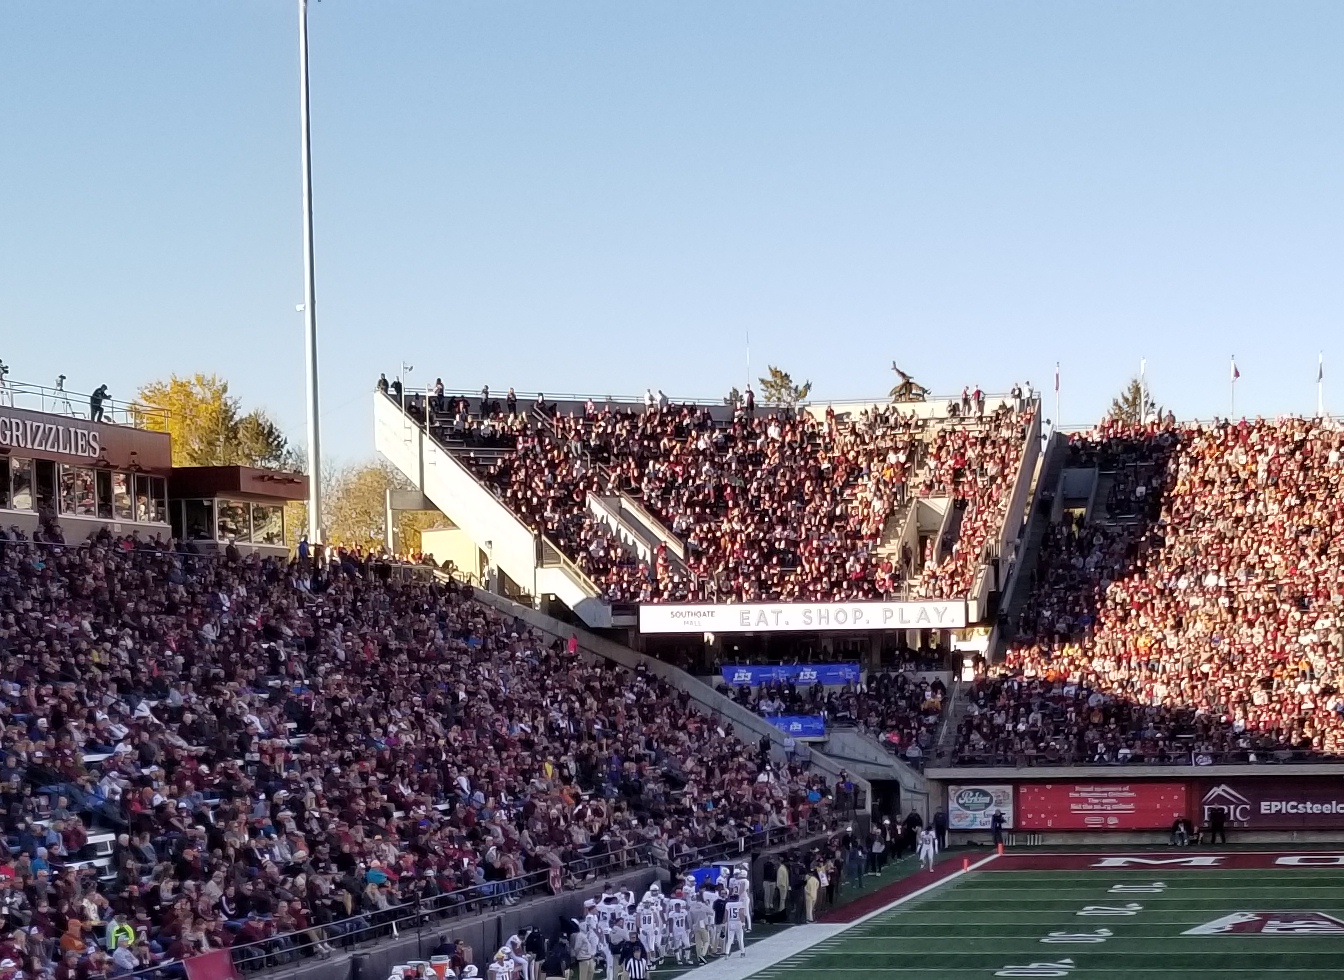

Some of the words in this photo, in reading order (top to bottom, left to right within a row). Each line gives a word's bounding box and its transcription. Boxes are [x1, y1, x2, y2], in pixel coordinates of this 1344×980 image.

[670, 610, 716, 619] SOUTHGATE
[740, 609, 789, 627] EAT.
[802, 608, 869, 625] SHOP.
[882, 606, 955, 625] PLAY.
